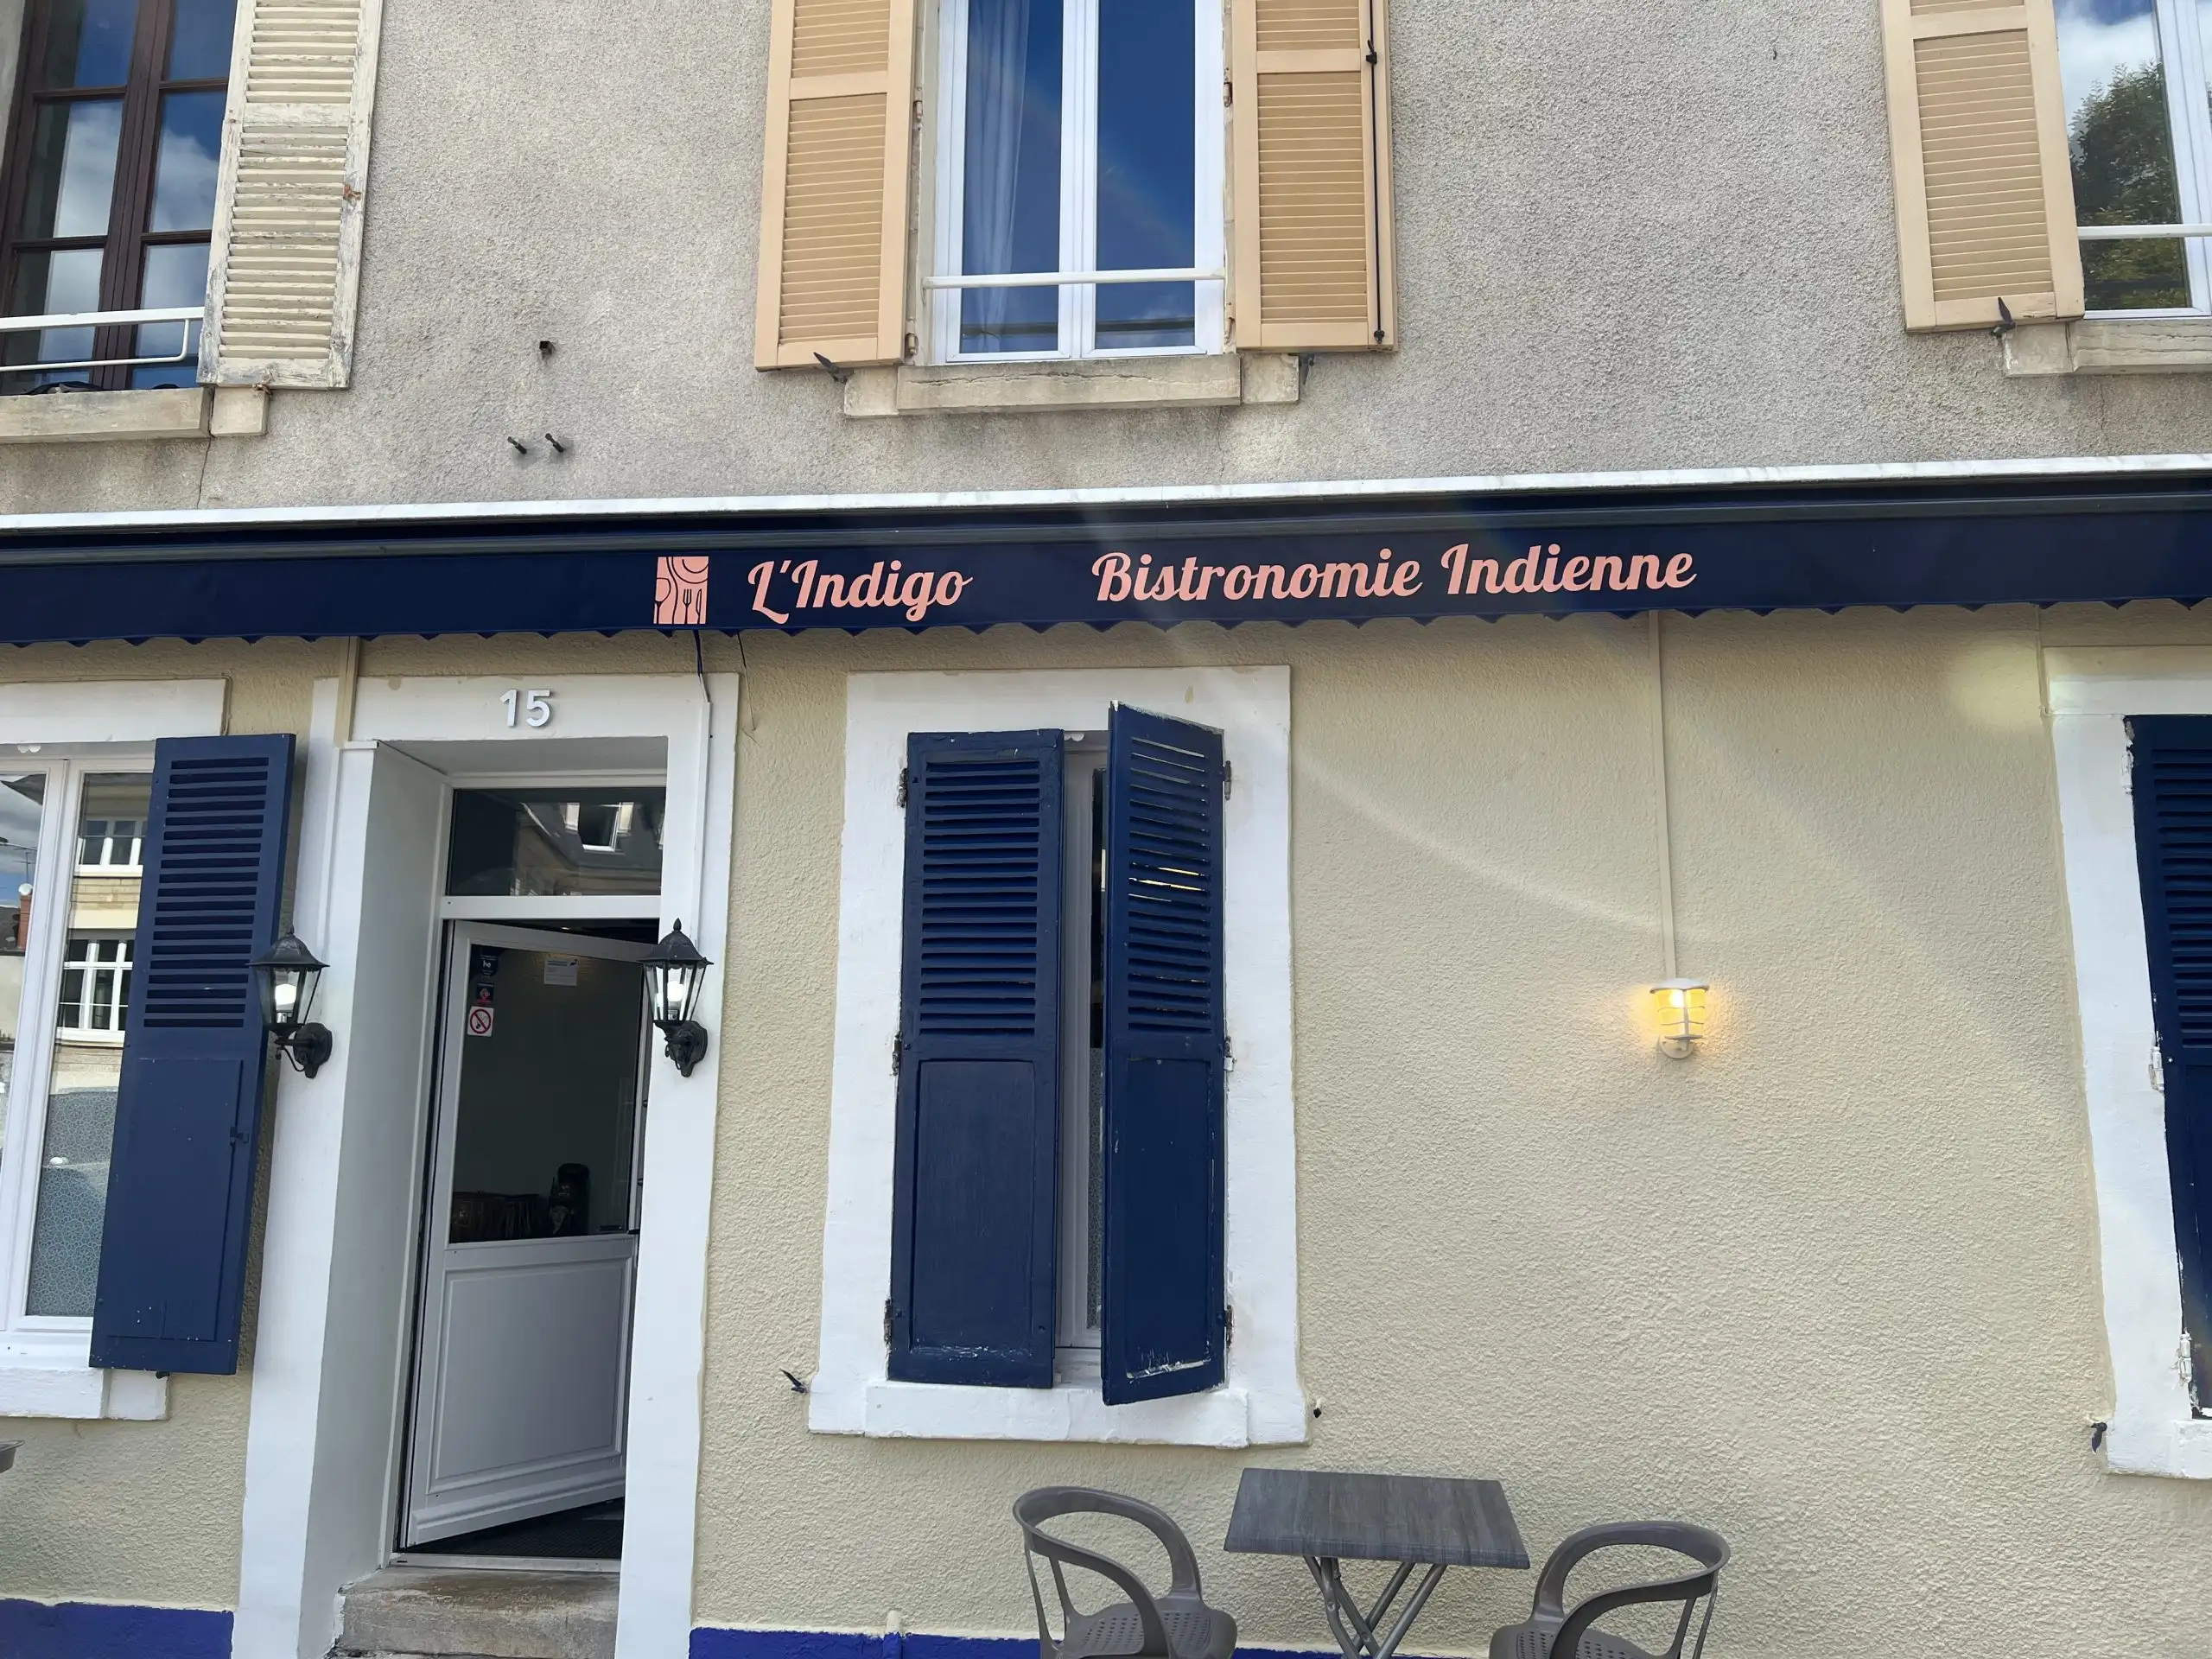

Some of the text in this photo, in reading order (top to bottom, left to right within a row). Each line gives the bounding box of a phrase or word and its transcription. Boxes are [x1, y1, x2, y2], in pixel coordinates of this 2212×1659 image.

[747, 543, 1697, 624] L'Indigo Bistronomie Indienne
[499, 689, 551, 728] 15
